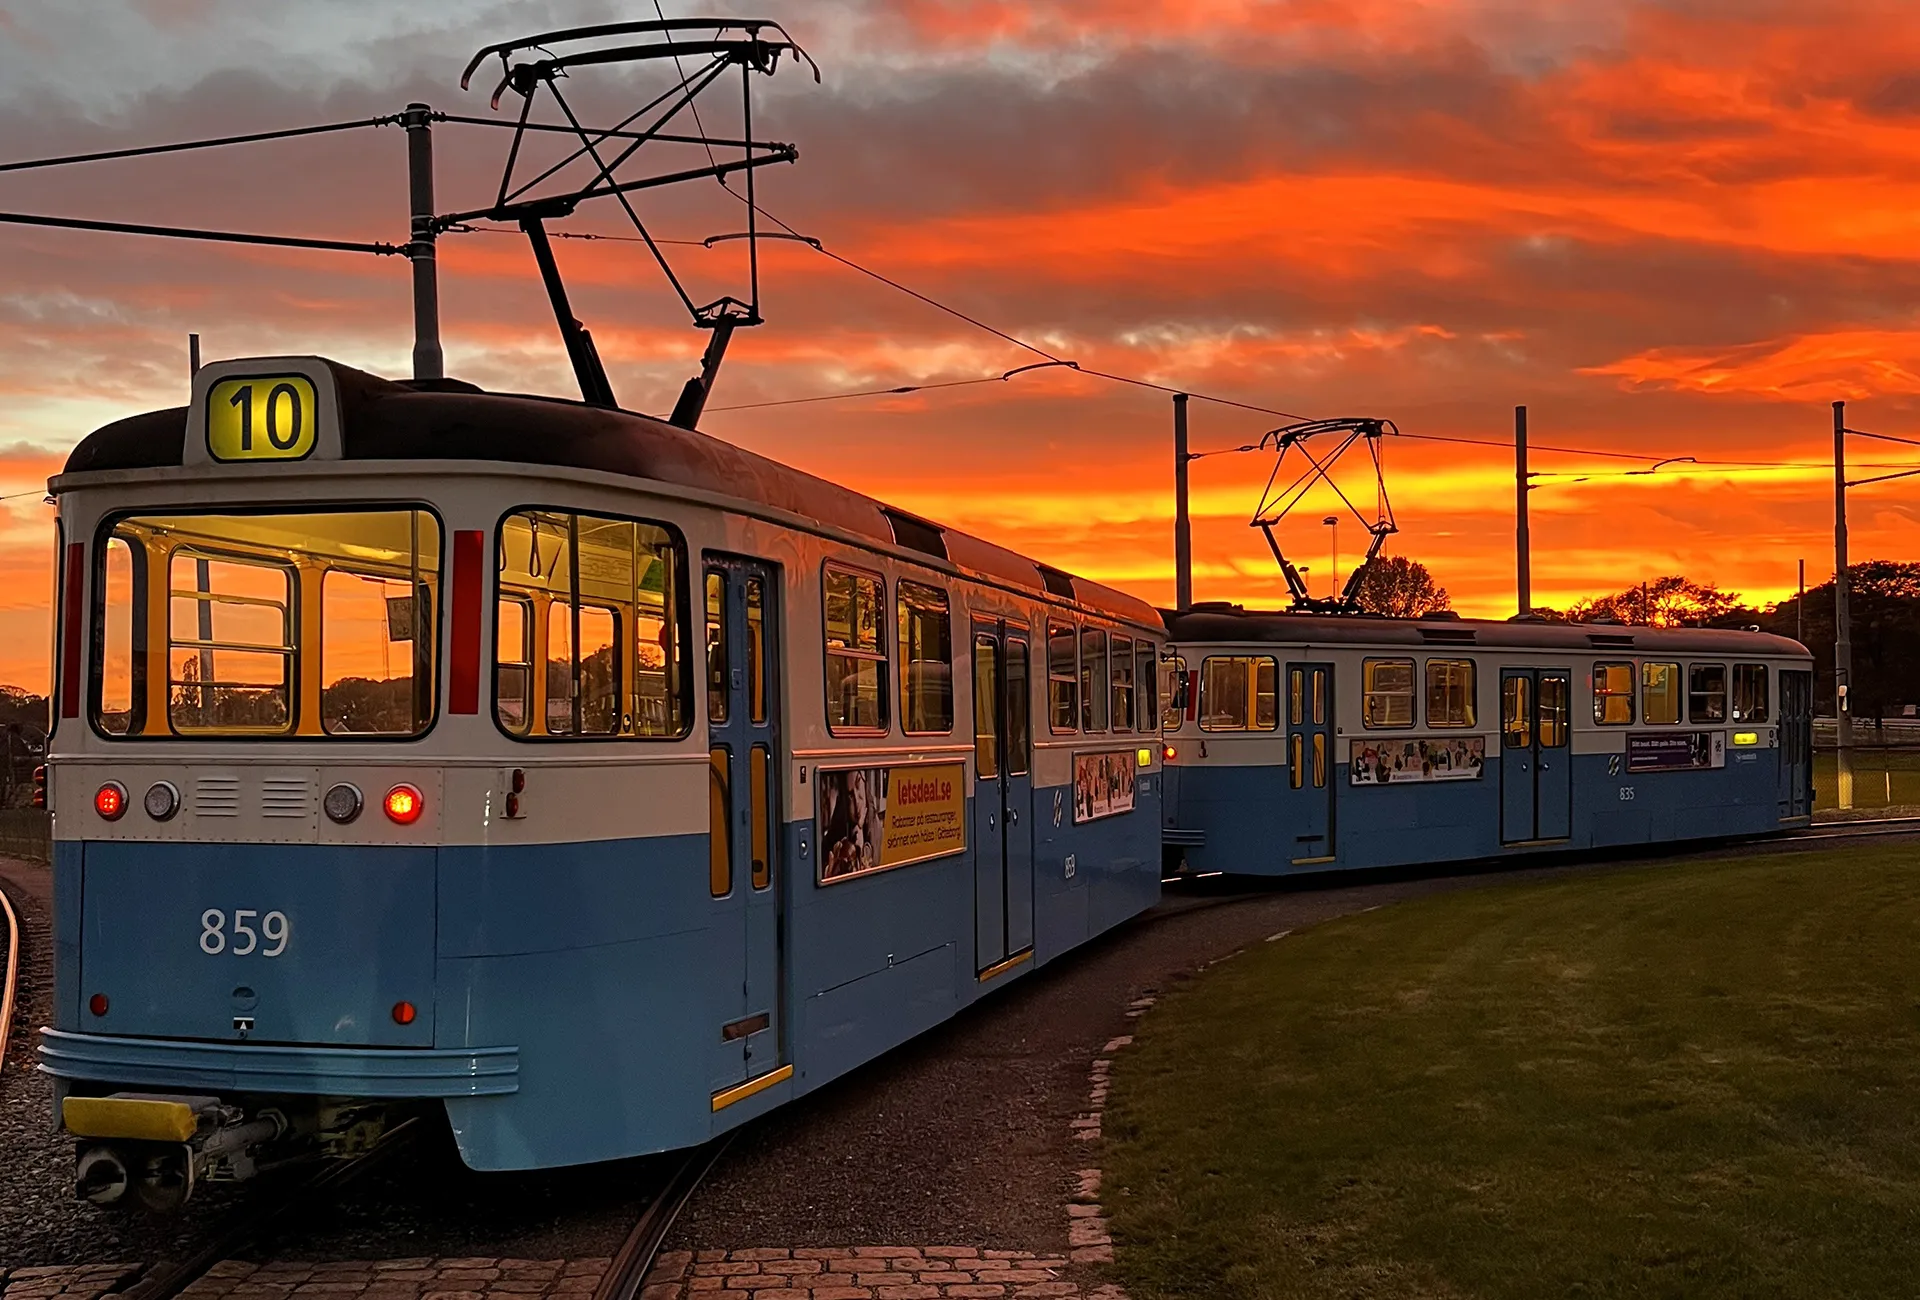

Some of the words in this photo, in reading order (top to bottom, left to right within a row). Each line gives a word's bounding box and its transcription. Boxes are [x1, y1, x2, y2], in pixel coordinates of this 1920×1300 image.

[229, 382, 302, 451] 10
[898, 777, 951, 805] letsdeal.se
[1619, 787, 1634, 800] 835
[200, 908, 289, 957] 859
